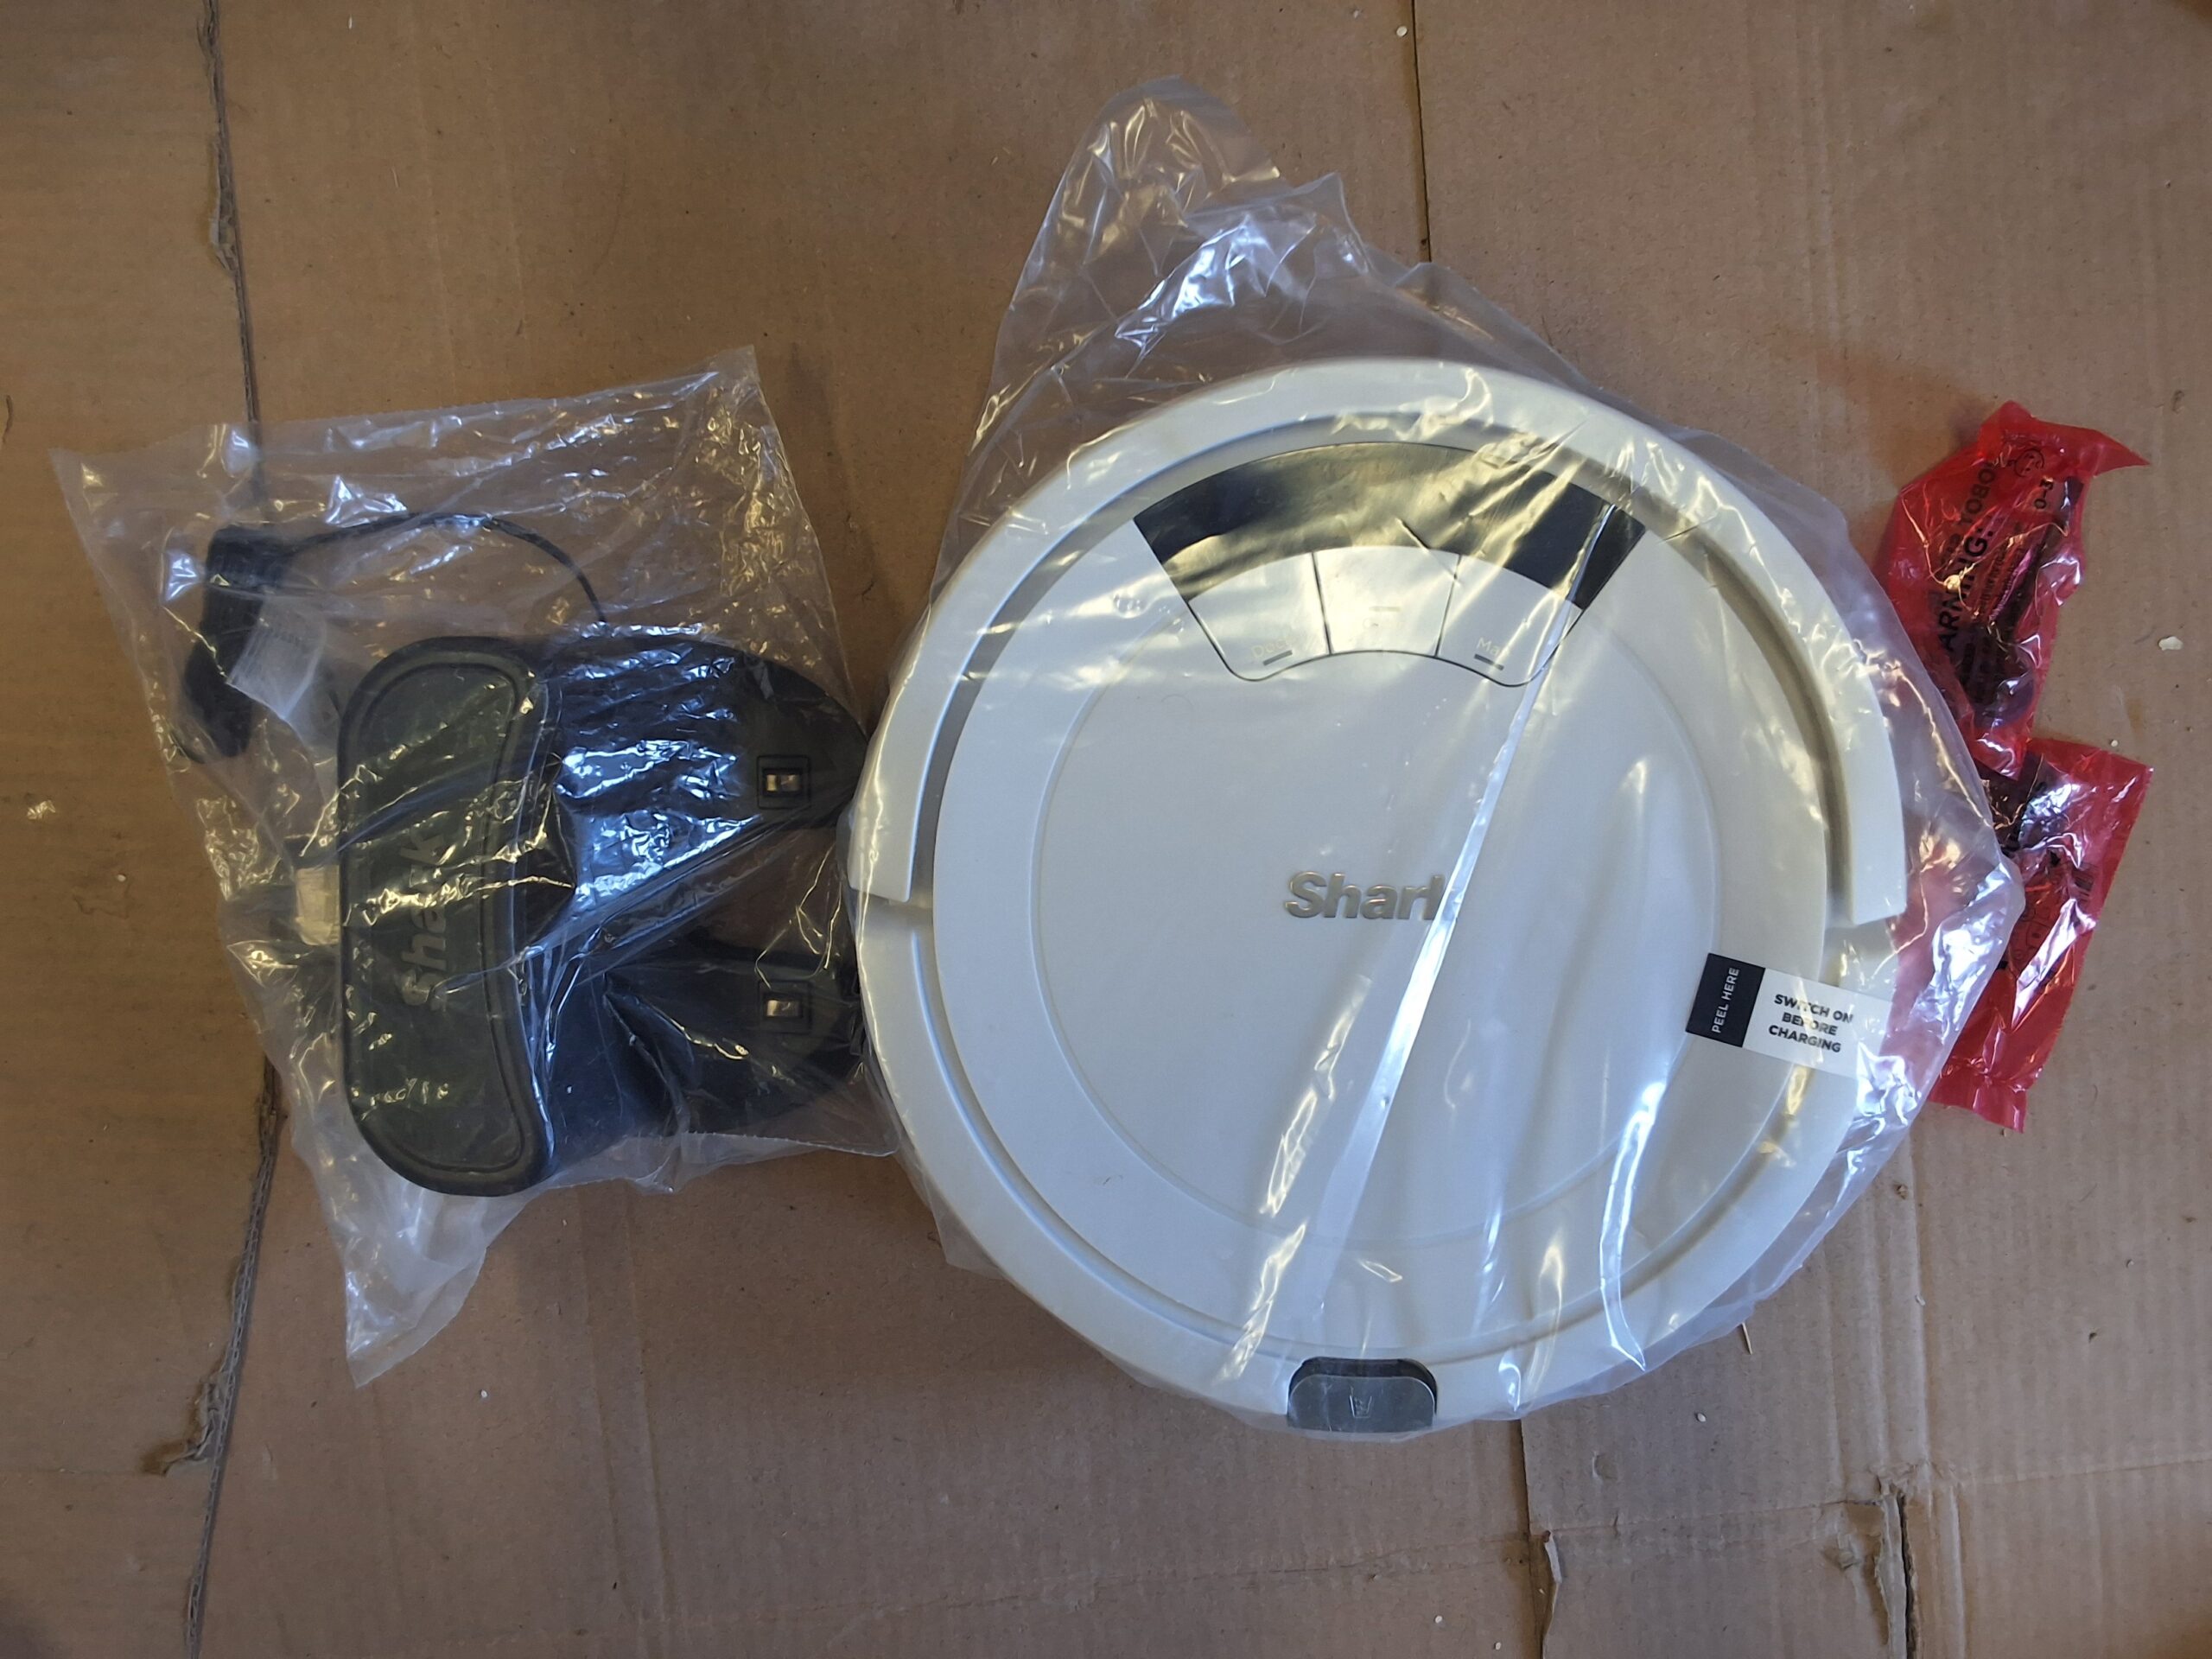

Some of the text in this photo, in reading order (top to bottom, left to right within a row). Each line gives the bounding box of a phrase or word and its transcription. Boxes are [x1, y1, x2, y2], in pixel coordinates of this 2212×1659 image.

[1712, 967, 1740, 1033] PEEL HERE
[1833, 1010, 1853, 1024] ON
[1769, 1025, 1841, 1052] CHARGING
